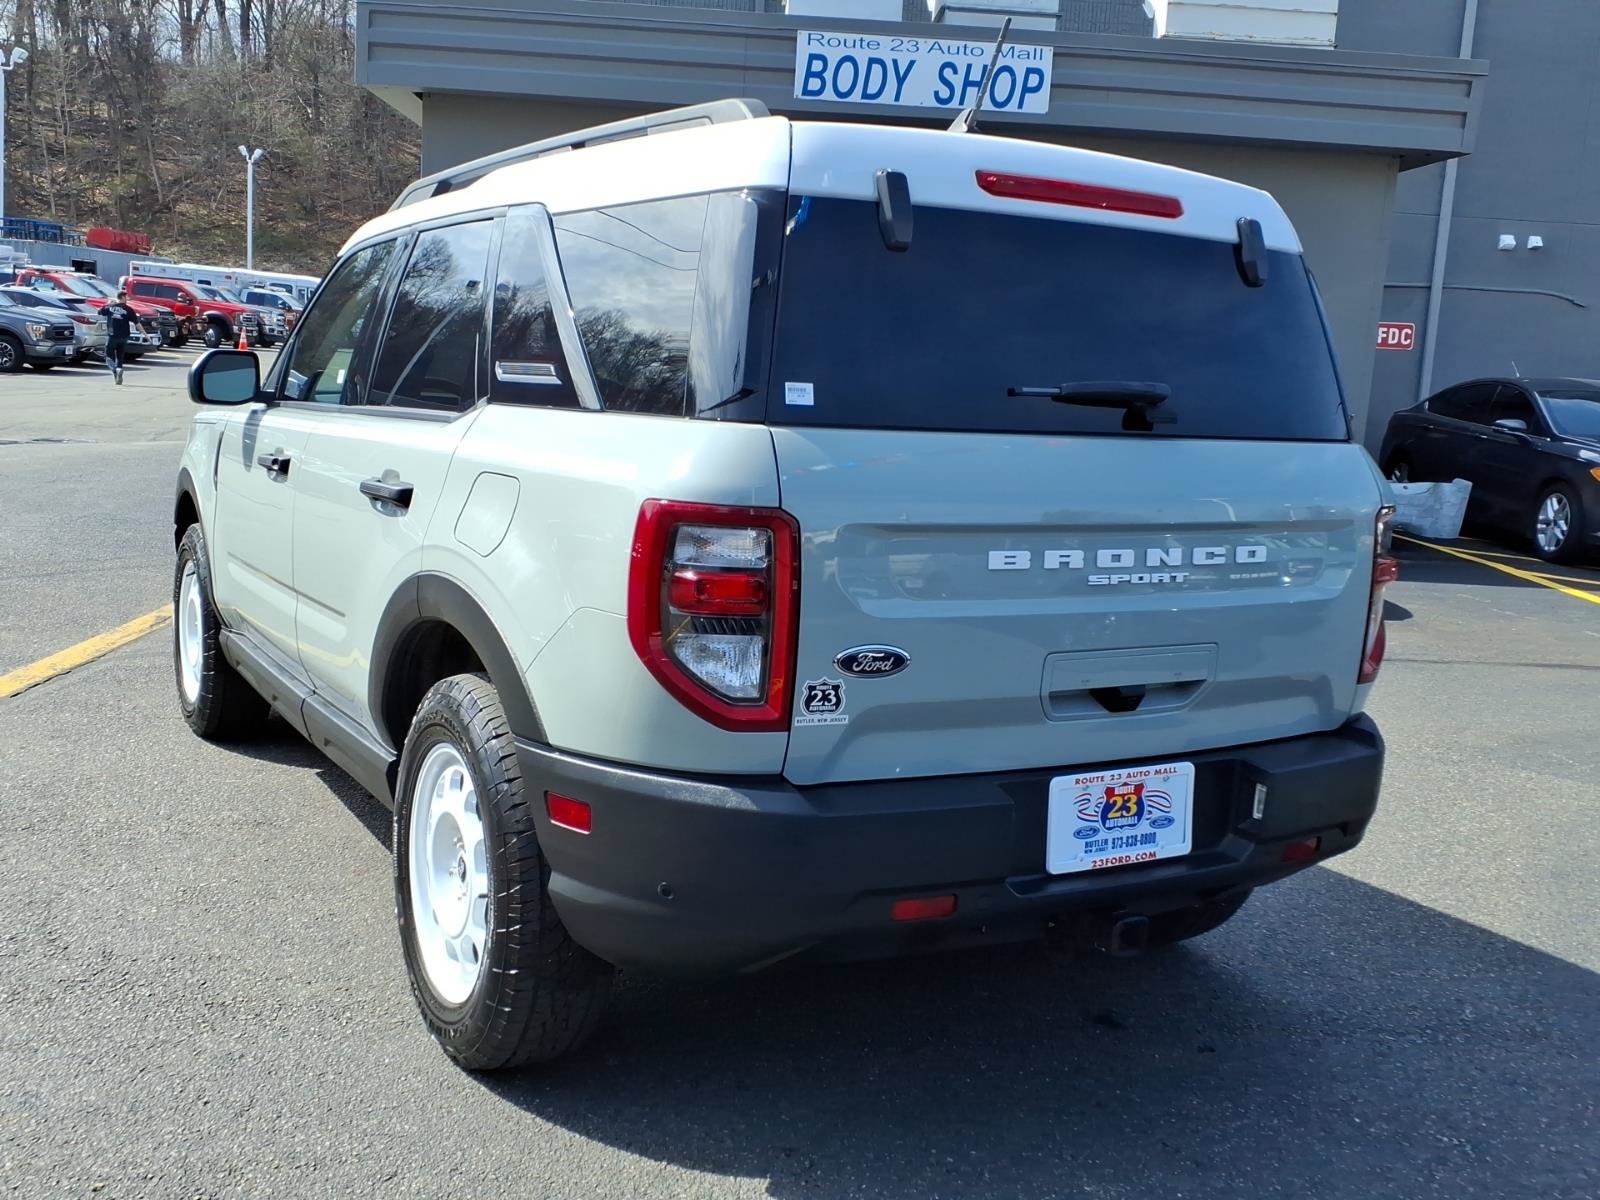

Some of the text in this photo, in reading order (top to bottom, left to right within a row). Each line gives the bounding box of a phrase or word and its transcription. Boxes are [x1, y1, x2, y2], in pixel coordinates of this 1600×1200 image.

[807, 33, 1044, 61] Route 23 Auto Mall
[801, 53, 1046, 110] BODY SHOP
[1377, 327, 1412, 345] FDC
[988, 545, 1268, 570] BRONCO
[1087, 572, 1190, 586] SPORT
[852, 652, 894, 672] Ford
[810, 690, 837, 706] 23
[1074, 775, 1105, 785] ROUTE
[1126, 770, 1150, 779] AUTO
[1154, 767, 1178, 776] MALL
[1114, 785, 1136, 795] ROUTE
[1107, 794, 1138, 819] 23
[1091, 851, 1157, 868] 23FORD.COM
